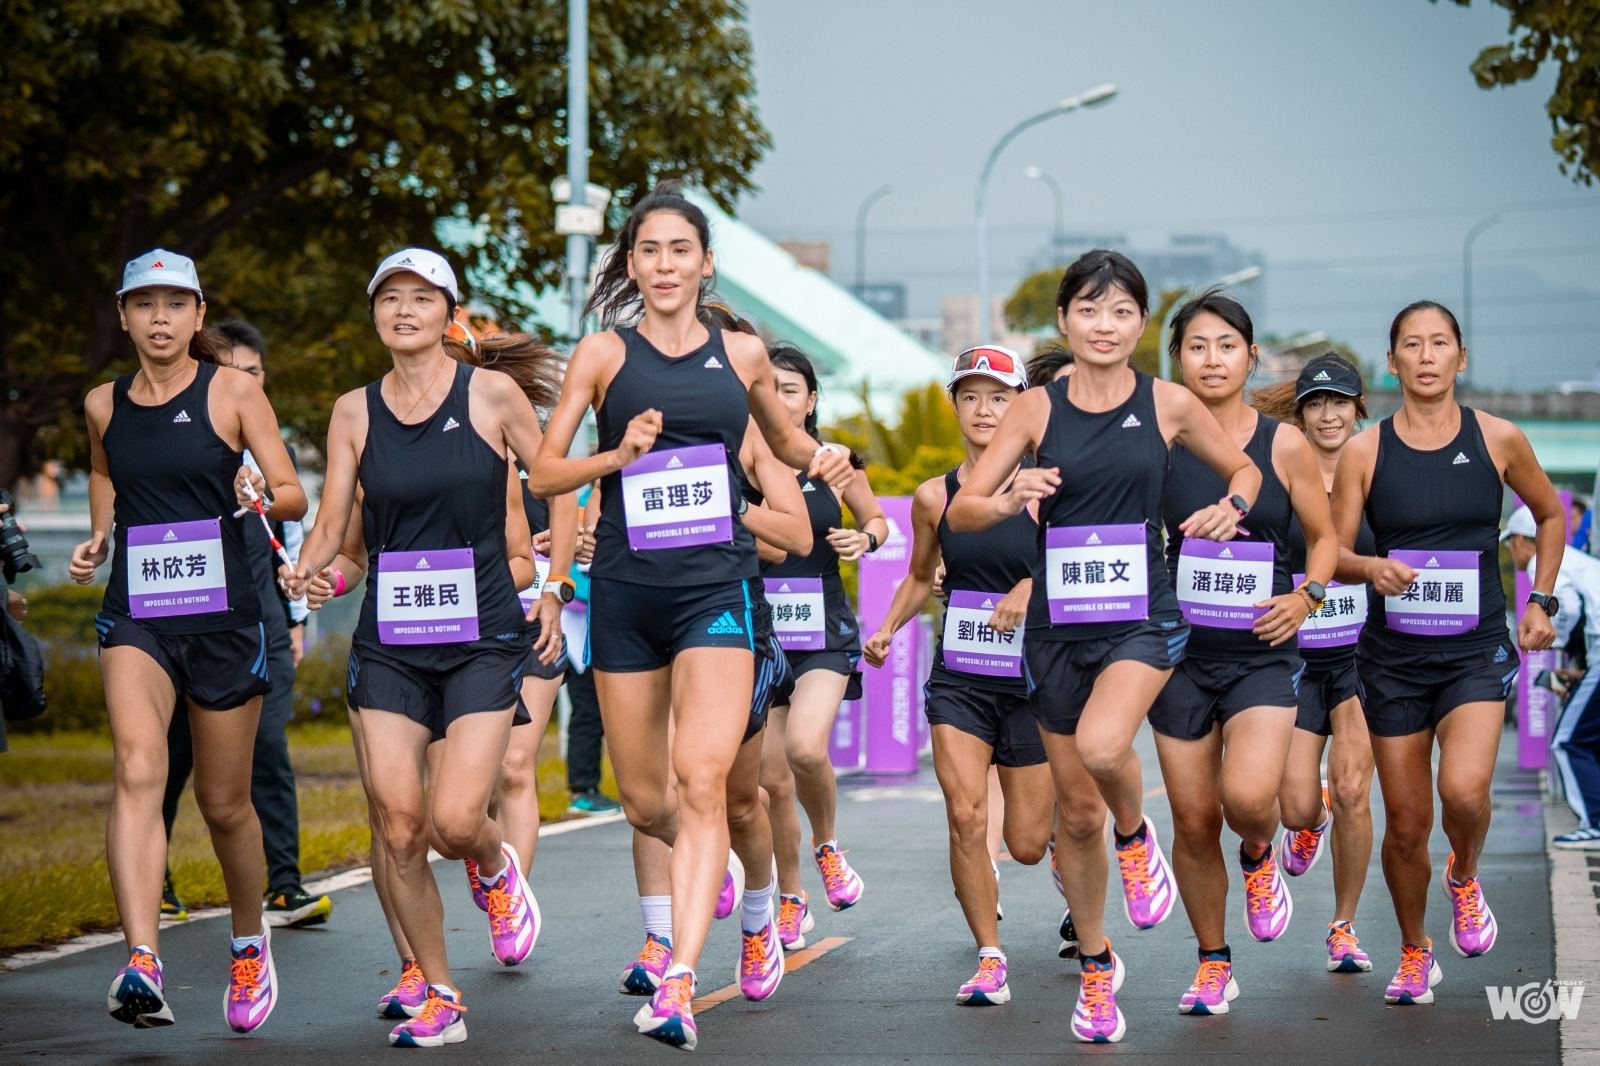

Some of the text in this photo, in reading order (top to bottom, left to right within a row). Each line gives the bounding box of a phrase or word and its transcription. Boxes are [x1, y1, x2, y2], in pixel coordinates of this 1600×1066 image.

[642, 481, 713, 512] 雷理莎
[645, 524, 716, 539] IMPOSSIBLE IS NOTHING
[141, 553, 207, 582] 林欣芳
[1192, 569, 1257, 595] 潘瑋婷
[143, 595, 210, 607] IMPOSSIBLE IS NOTHING
[393, 583, 460, 608] 王雅民
[770, 603, 812, 622] 婷婷
[1063, 601, 1131, 612] IMPOSSIBLE IS NOTHING
[1190, 607, 1222, 618] IMPOSSIBLE
[1229, 611, 1254, 619] NOTHING
[1399, 617, 1463, 627] IMPOSSIBLE IS NOTHING
[393, 624, 461, 635] IMPOSSIBLE IS NOTHING
[707, 626, 744, 635] adidas
[1303, 632, 1331, 641] IMPOSSIBLE
[1337, 629, 1358, 637] NOTHING
[956, 656, 984, 666] IMPOSSIBLE
